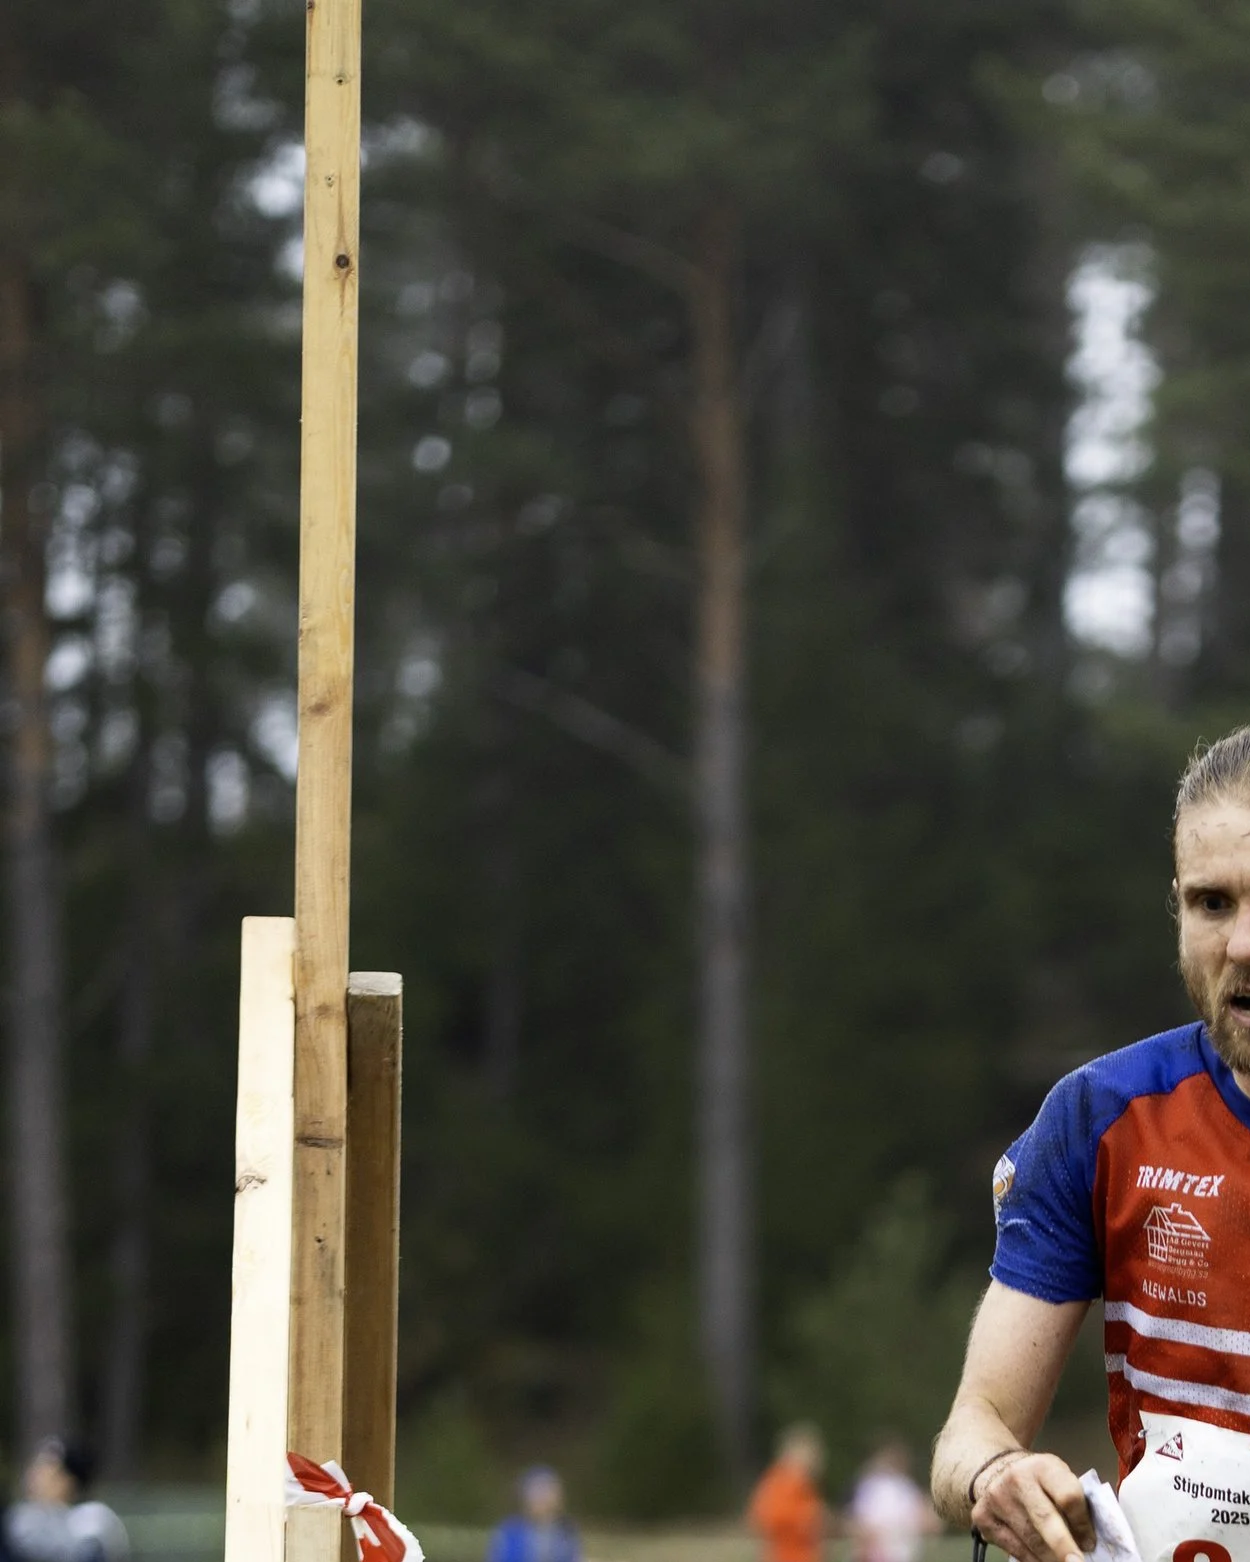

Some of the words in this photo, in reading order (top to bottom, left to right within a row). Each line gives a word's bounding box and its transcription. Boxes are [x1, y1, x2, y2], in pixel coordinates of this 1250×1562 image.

[1136, 1165, 1224, 1198] TRIMTEX
[1142, 1279, 1207, 1307] ALEWALDS
[1211, 1508, 1250, 1526] 2025
